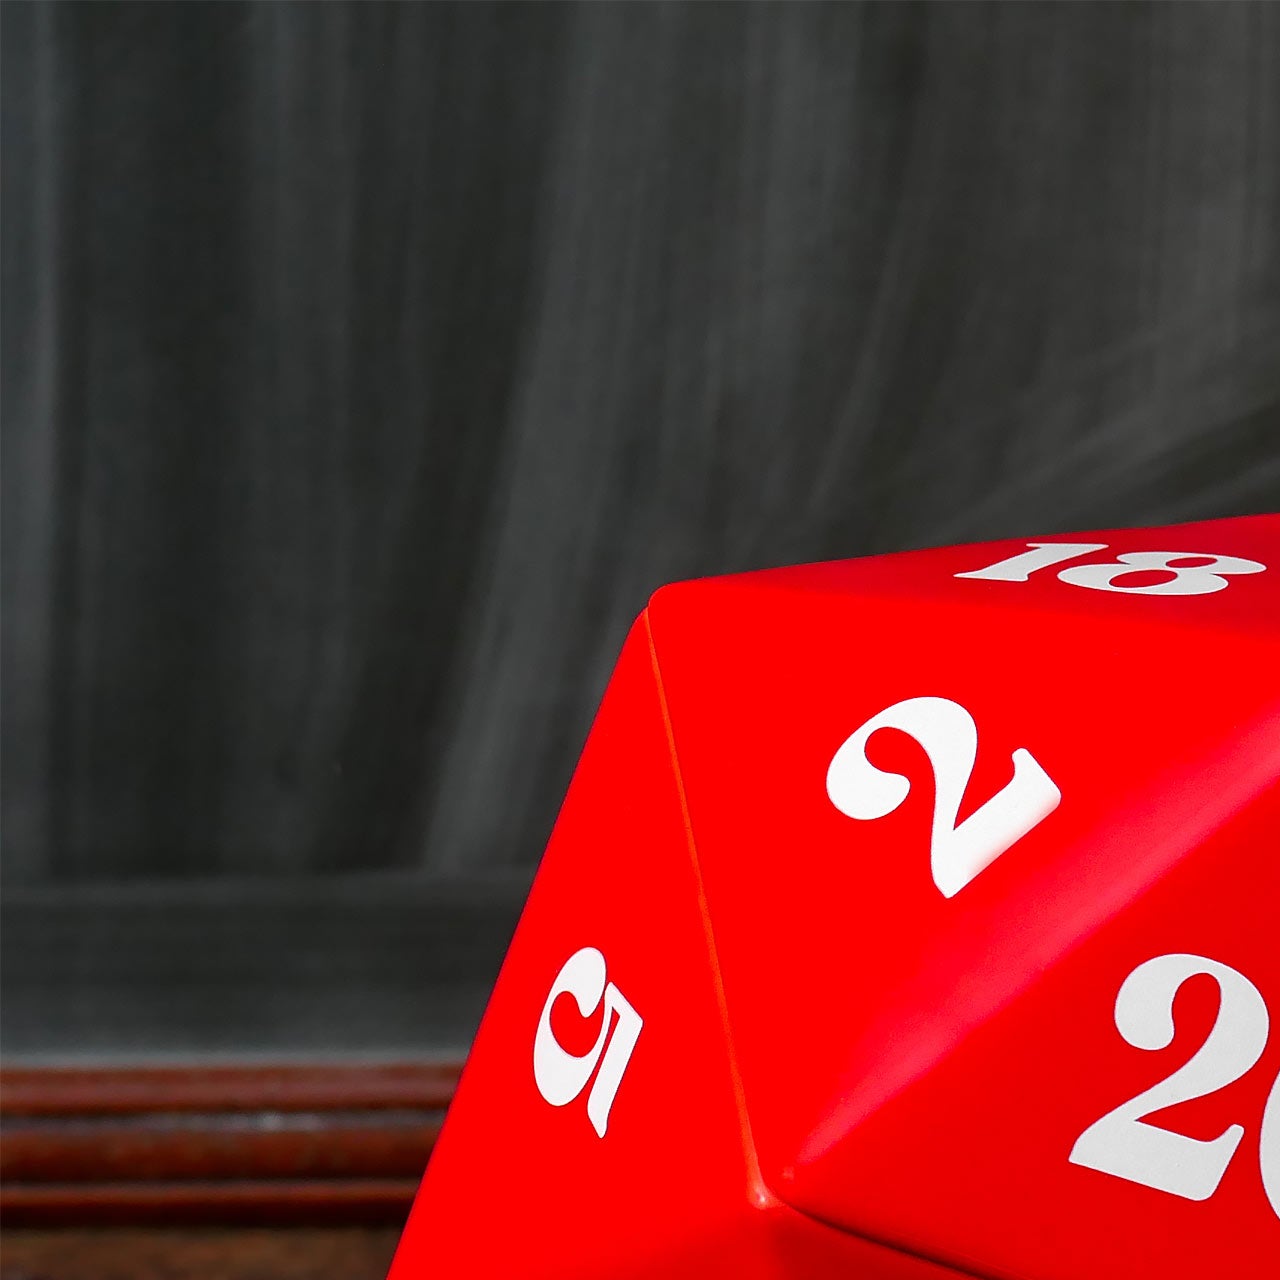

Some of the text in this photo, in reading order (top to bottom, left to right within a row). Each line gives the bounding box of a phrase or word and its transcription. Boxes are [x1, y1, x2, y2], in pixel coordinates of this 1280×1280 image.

[953, 542, 1266, 595] 18
[826, 697, 1061, 898] 2
[533, 947, 643, 1138] 5
